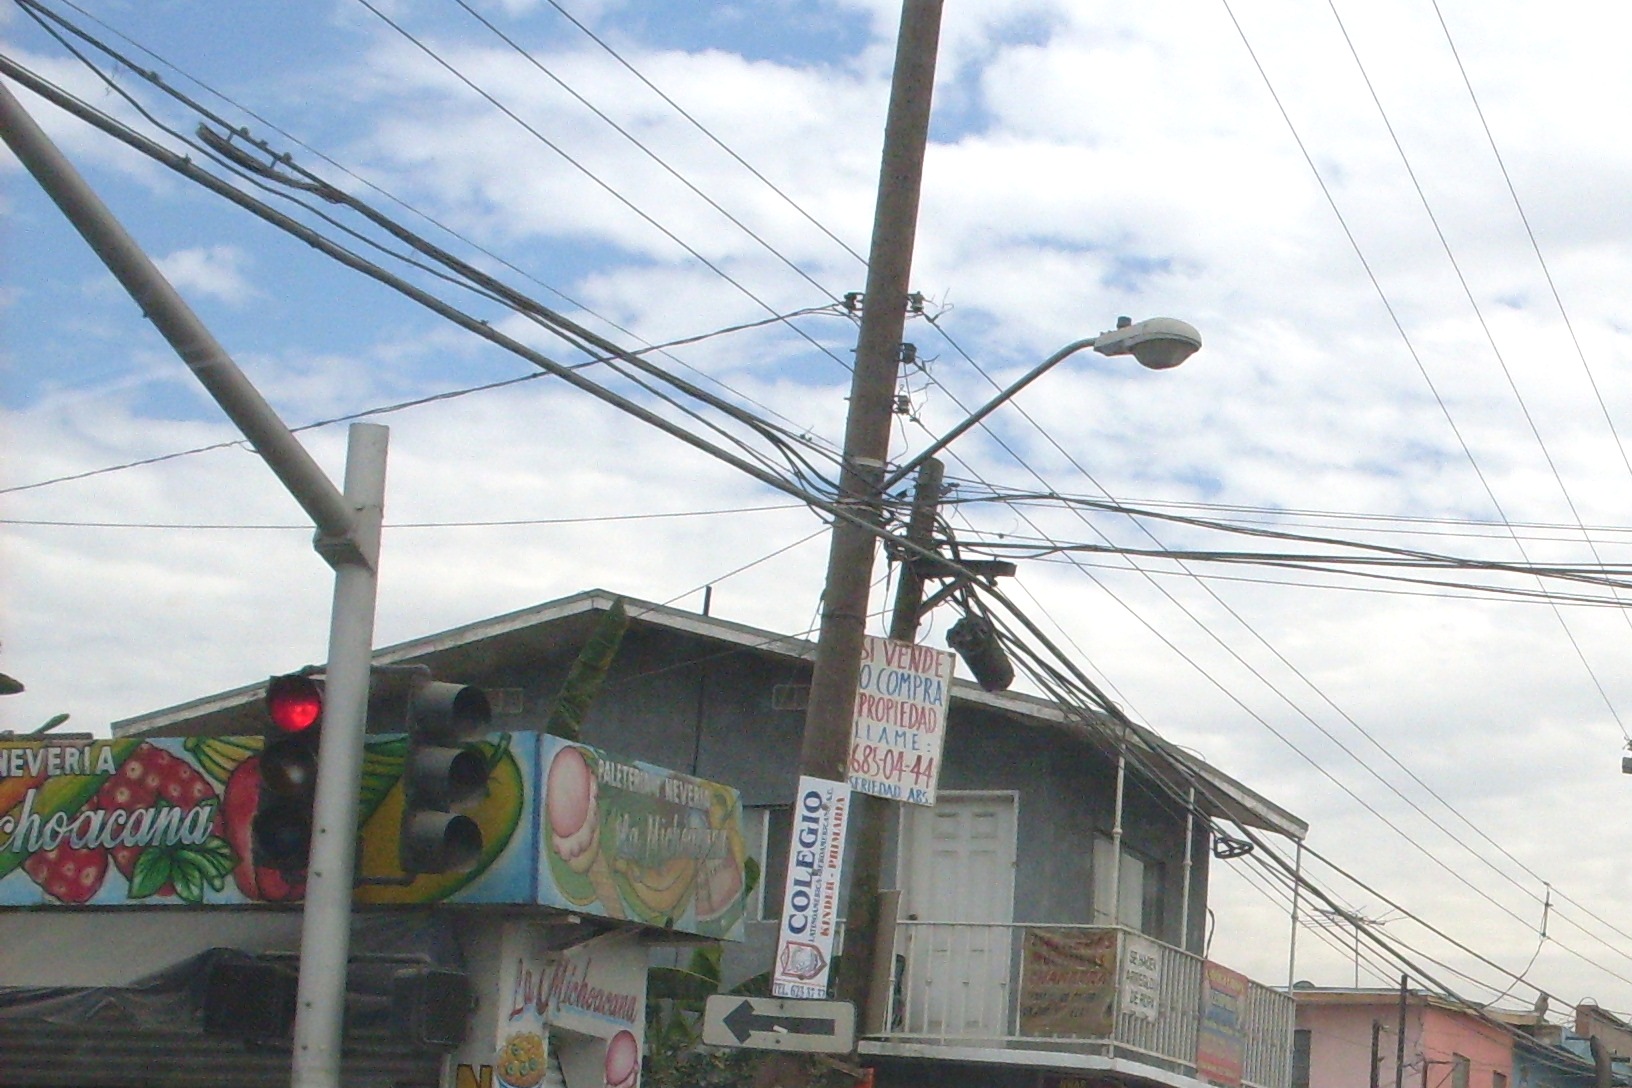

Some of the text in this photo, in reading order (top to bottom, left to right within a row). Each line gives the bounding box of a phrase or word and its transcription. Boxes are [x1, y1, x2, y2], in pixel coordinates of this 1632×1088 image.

[884, 640, 945, 678] VENDE
[860, 664, 943, 706] O COMPRA
[858, 692, 938, 733] PROPIEDAD
[788, 790, 823, 935] COLEGIO
[820, 881, 836, 937] KINDER
[828, 797, 846, 869] PRIMARIA
